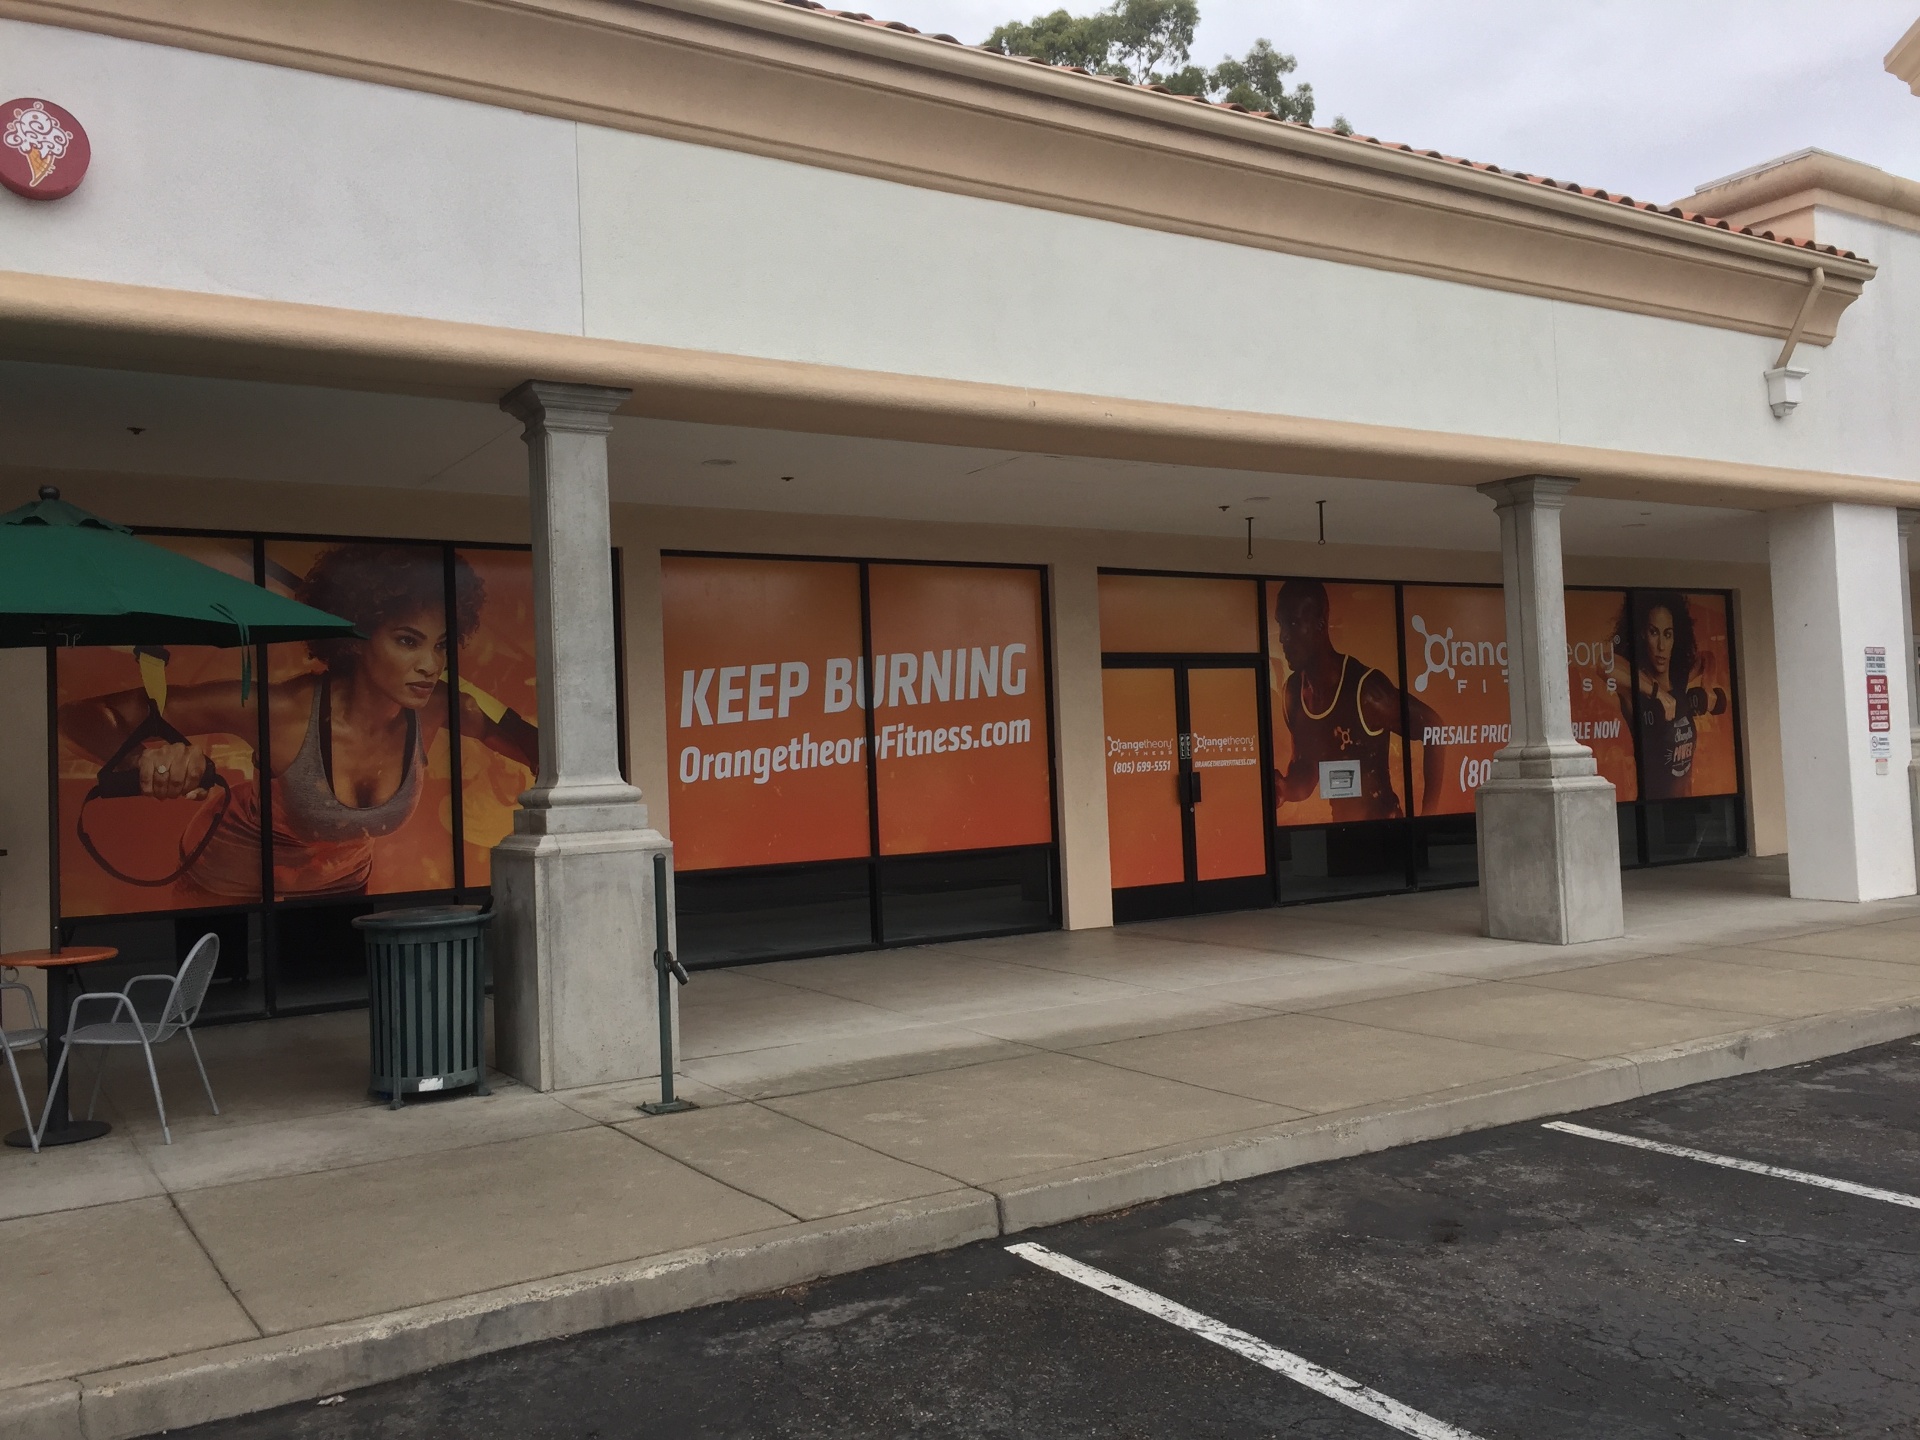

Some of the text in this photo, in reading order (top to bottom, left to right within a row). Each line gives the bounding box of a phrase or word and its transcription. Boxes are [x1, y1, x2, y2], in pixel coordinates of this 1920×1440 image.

[680, 643, 1027, 728] KEEP BURNING
[1457, 677, 1618, 694] FISS
[1642, 710, 1655, 726] 10
[1423, 724, 1478, 746] PRESALE
[1480, 724, 1512, 743] PRIC
[1593, 720, 1621, 739] NOW
[1673, 742, 1693, 763] POWER
[1113, 760, 1171, 775] (805) 699-5551
